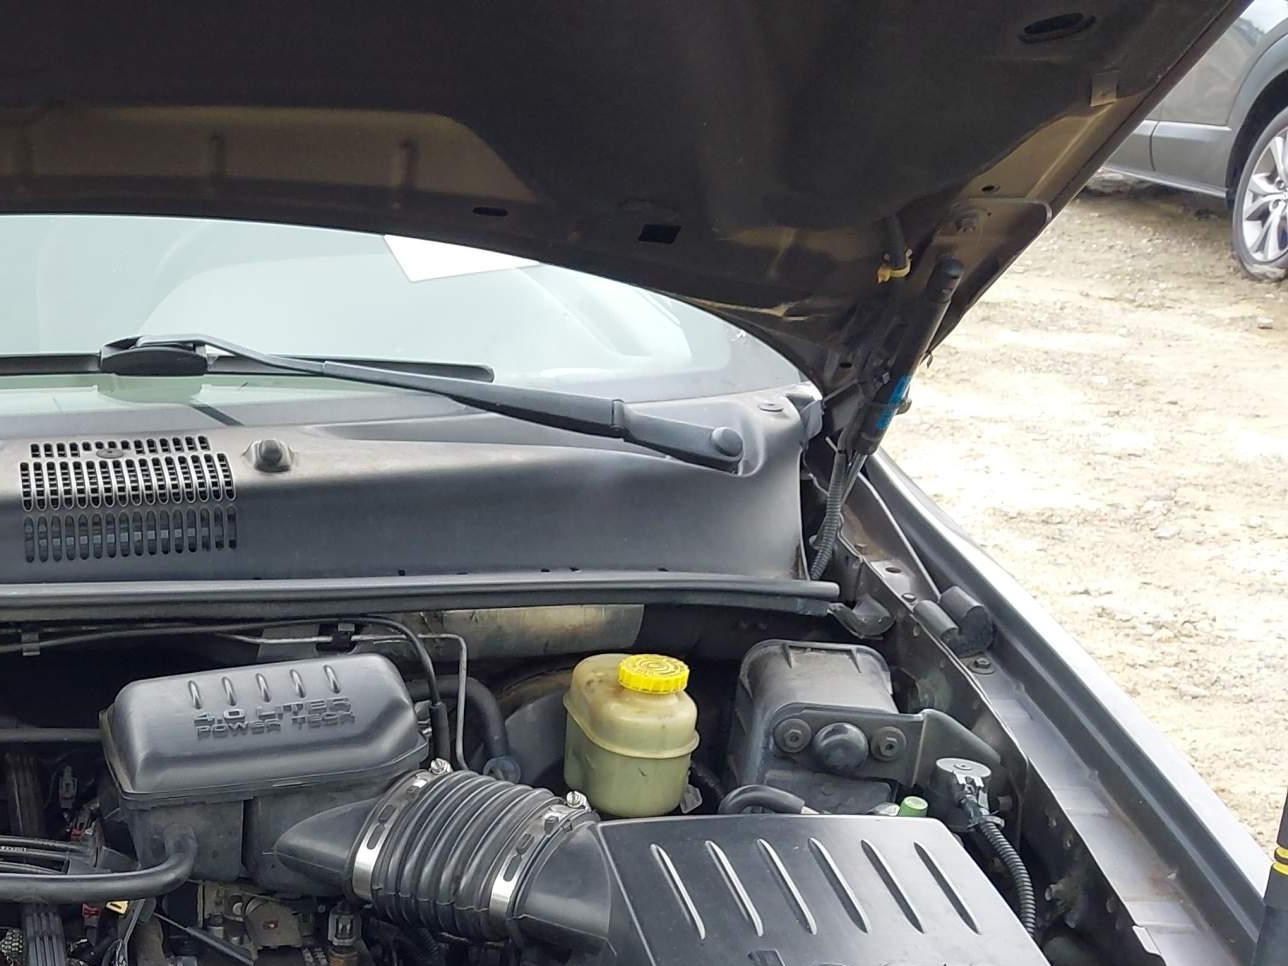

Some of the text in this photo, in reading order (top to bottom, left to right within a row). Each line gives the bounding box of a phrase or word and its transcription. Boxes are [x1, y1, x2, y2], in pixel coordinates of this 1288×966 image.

[255, 697, 352, 721] LITER
[197, 711, 356, 740] POWER TECH
